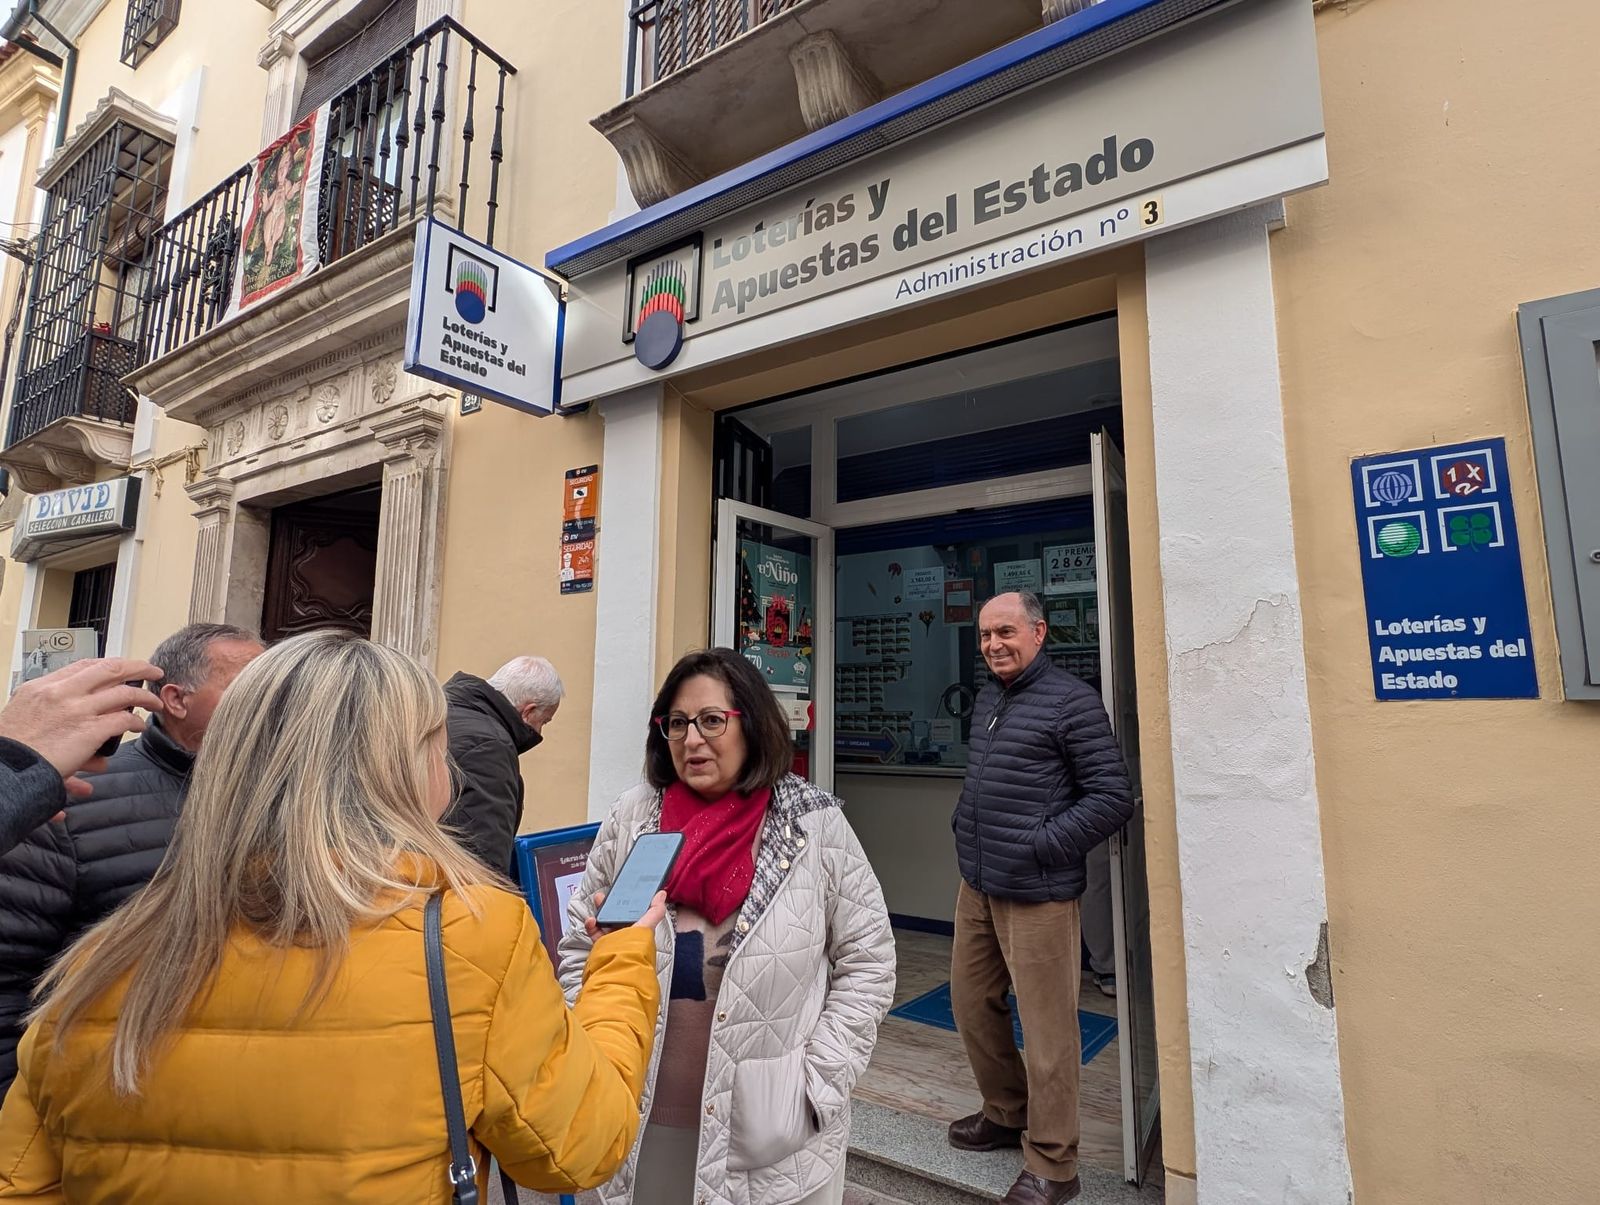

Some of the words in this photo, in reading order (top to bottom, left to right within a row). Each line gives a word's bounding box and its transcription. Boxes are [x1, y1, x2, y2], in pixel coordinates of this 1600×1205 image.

[711, 233, 880, 315] Apuestas
[893, 193, 957, 252] del
[973, 134, 1154, 226] Estado
[713, 193, 855, 270] Loterías
[867, 178, 890, 222] y
[895, 228, 1083, 300] Administración
[1143, 200, 1158, 225] 3
[442, 316, 498, 350] Loterías
[500, 343, 508, 356] y
[440, 349, 488, 377] Estado
[441, 333, 504, 368] Apuestas
[507, 360, 526, 376] del
[464, 394, 477, 407] 29
[1446, 467, 1457, 482] 1
[1465, 463, 1482, 481] X
[36, 483, 111, 519] DAVID
[1455, 482, 1479, 496] 2
[29, 518, 68, 533] SELECCION
[71, 509, 114, 526] CABALLERO
[563, 541, 593, 553] SEGURIDAD
[765, 560, 798, 585] Niño
[1375, 615, 1466, 636] Loterías
[1472, 617, 1487, 635] y
[54, 637, 69, 646] IC
[1379, 642, 1482, 667] Apuestas
[1489, 639, 1527, 659] del
[1381, 671, 1458, 690] Estado
